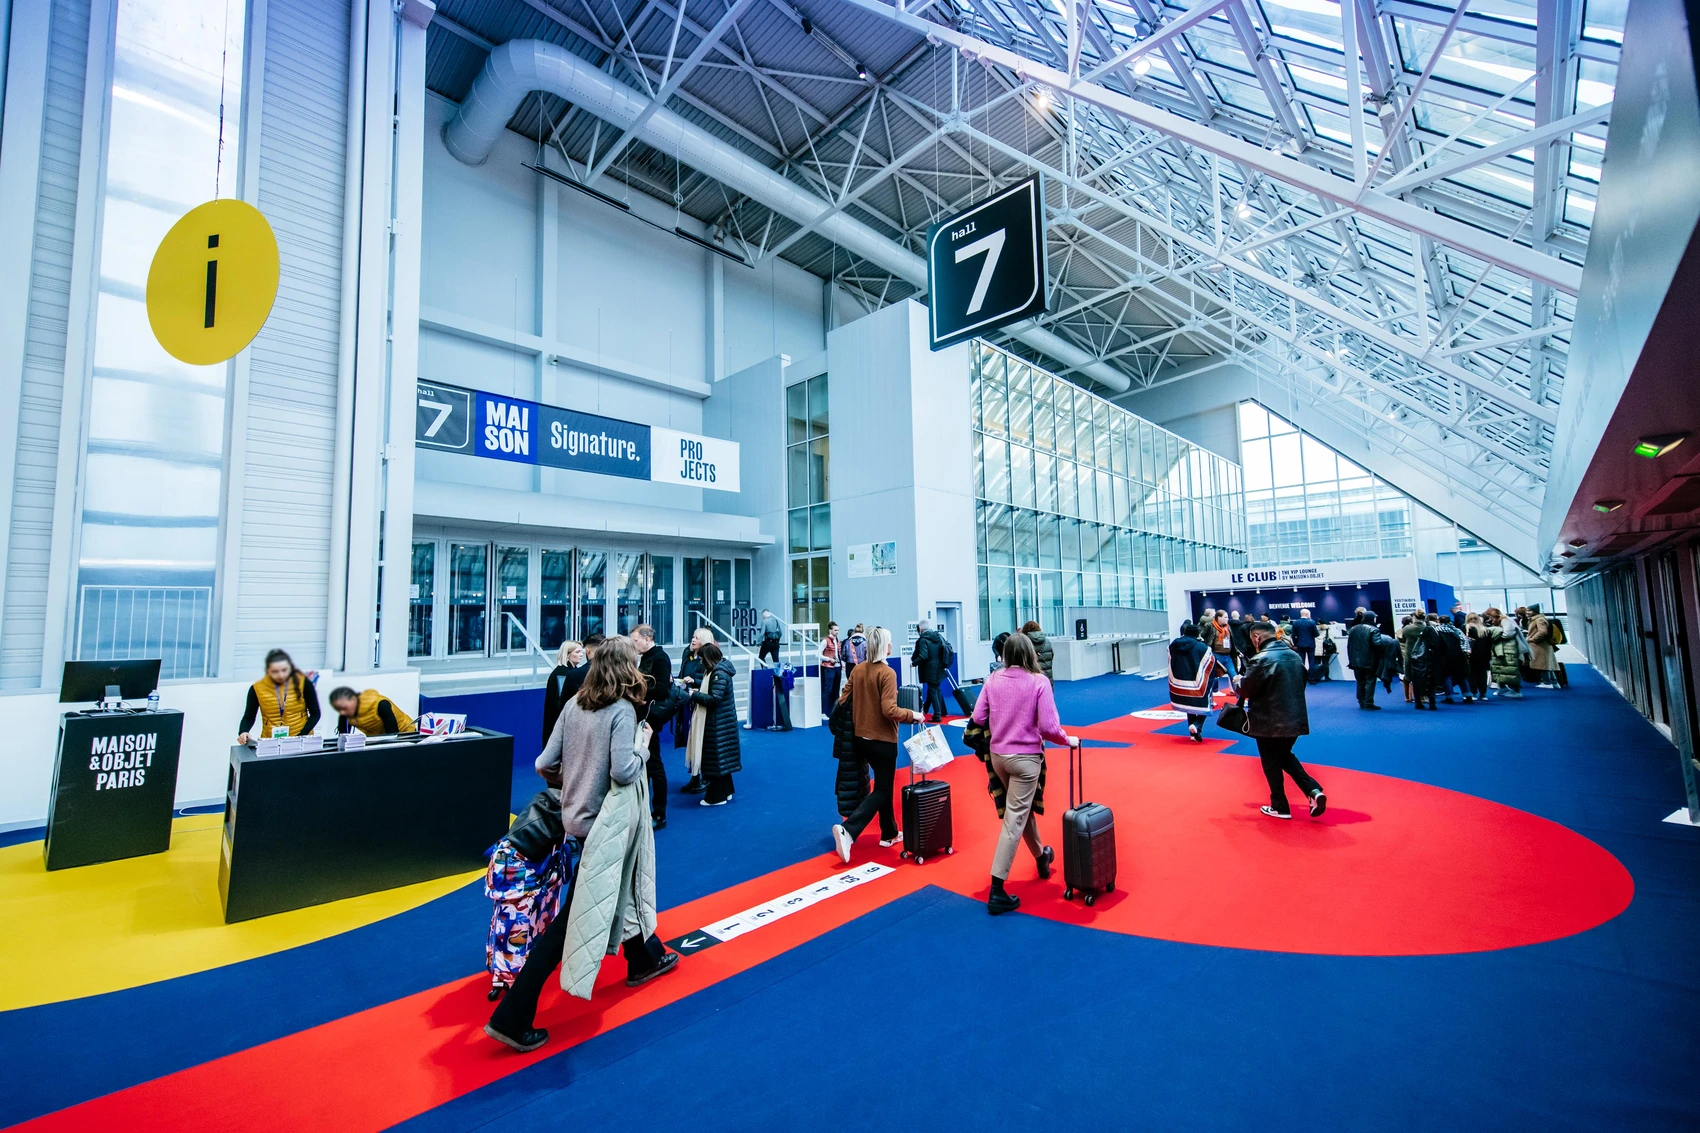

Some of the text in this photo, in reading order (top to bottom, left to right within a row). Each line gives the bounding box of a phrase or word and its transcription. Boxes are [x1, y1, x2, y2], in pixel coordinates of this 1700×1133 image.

[951, 221, 977, 242] hall
[954, 227, 1006, 316] 7
[417, 388, 435, 397] hall
[418, 398, 453, 438] 7
[486, 400, 529, 431] MAI
[484, 425, 529, 456] SON
[550, 420, 641, 462] Signature.
[680, 438, 703, 461] PRO
[680, 460, 716, 483] JECTS
[1231, 571, 1277, 584] LE CLUB
[1290, 601, 1316, 609] WELCOME
[732, 607, 758, 628] PRO
[91, 732, 158, 755] MAISON
[89, 749, 156, 771] &OBJET
[96, 768, 146, 791] PARIS
[787, 897, 803, 905] 3
[756, 909, 774, 918] 2
[723, 922, 740, 931] 1
